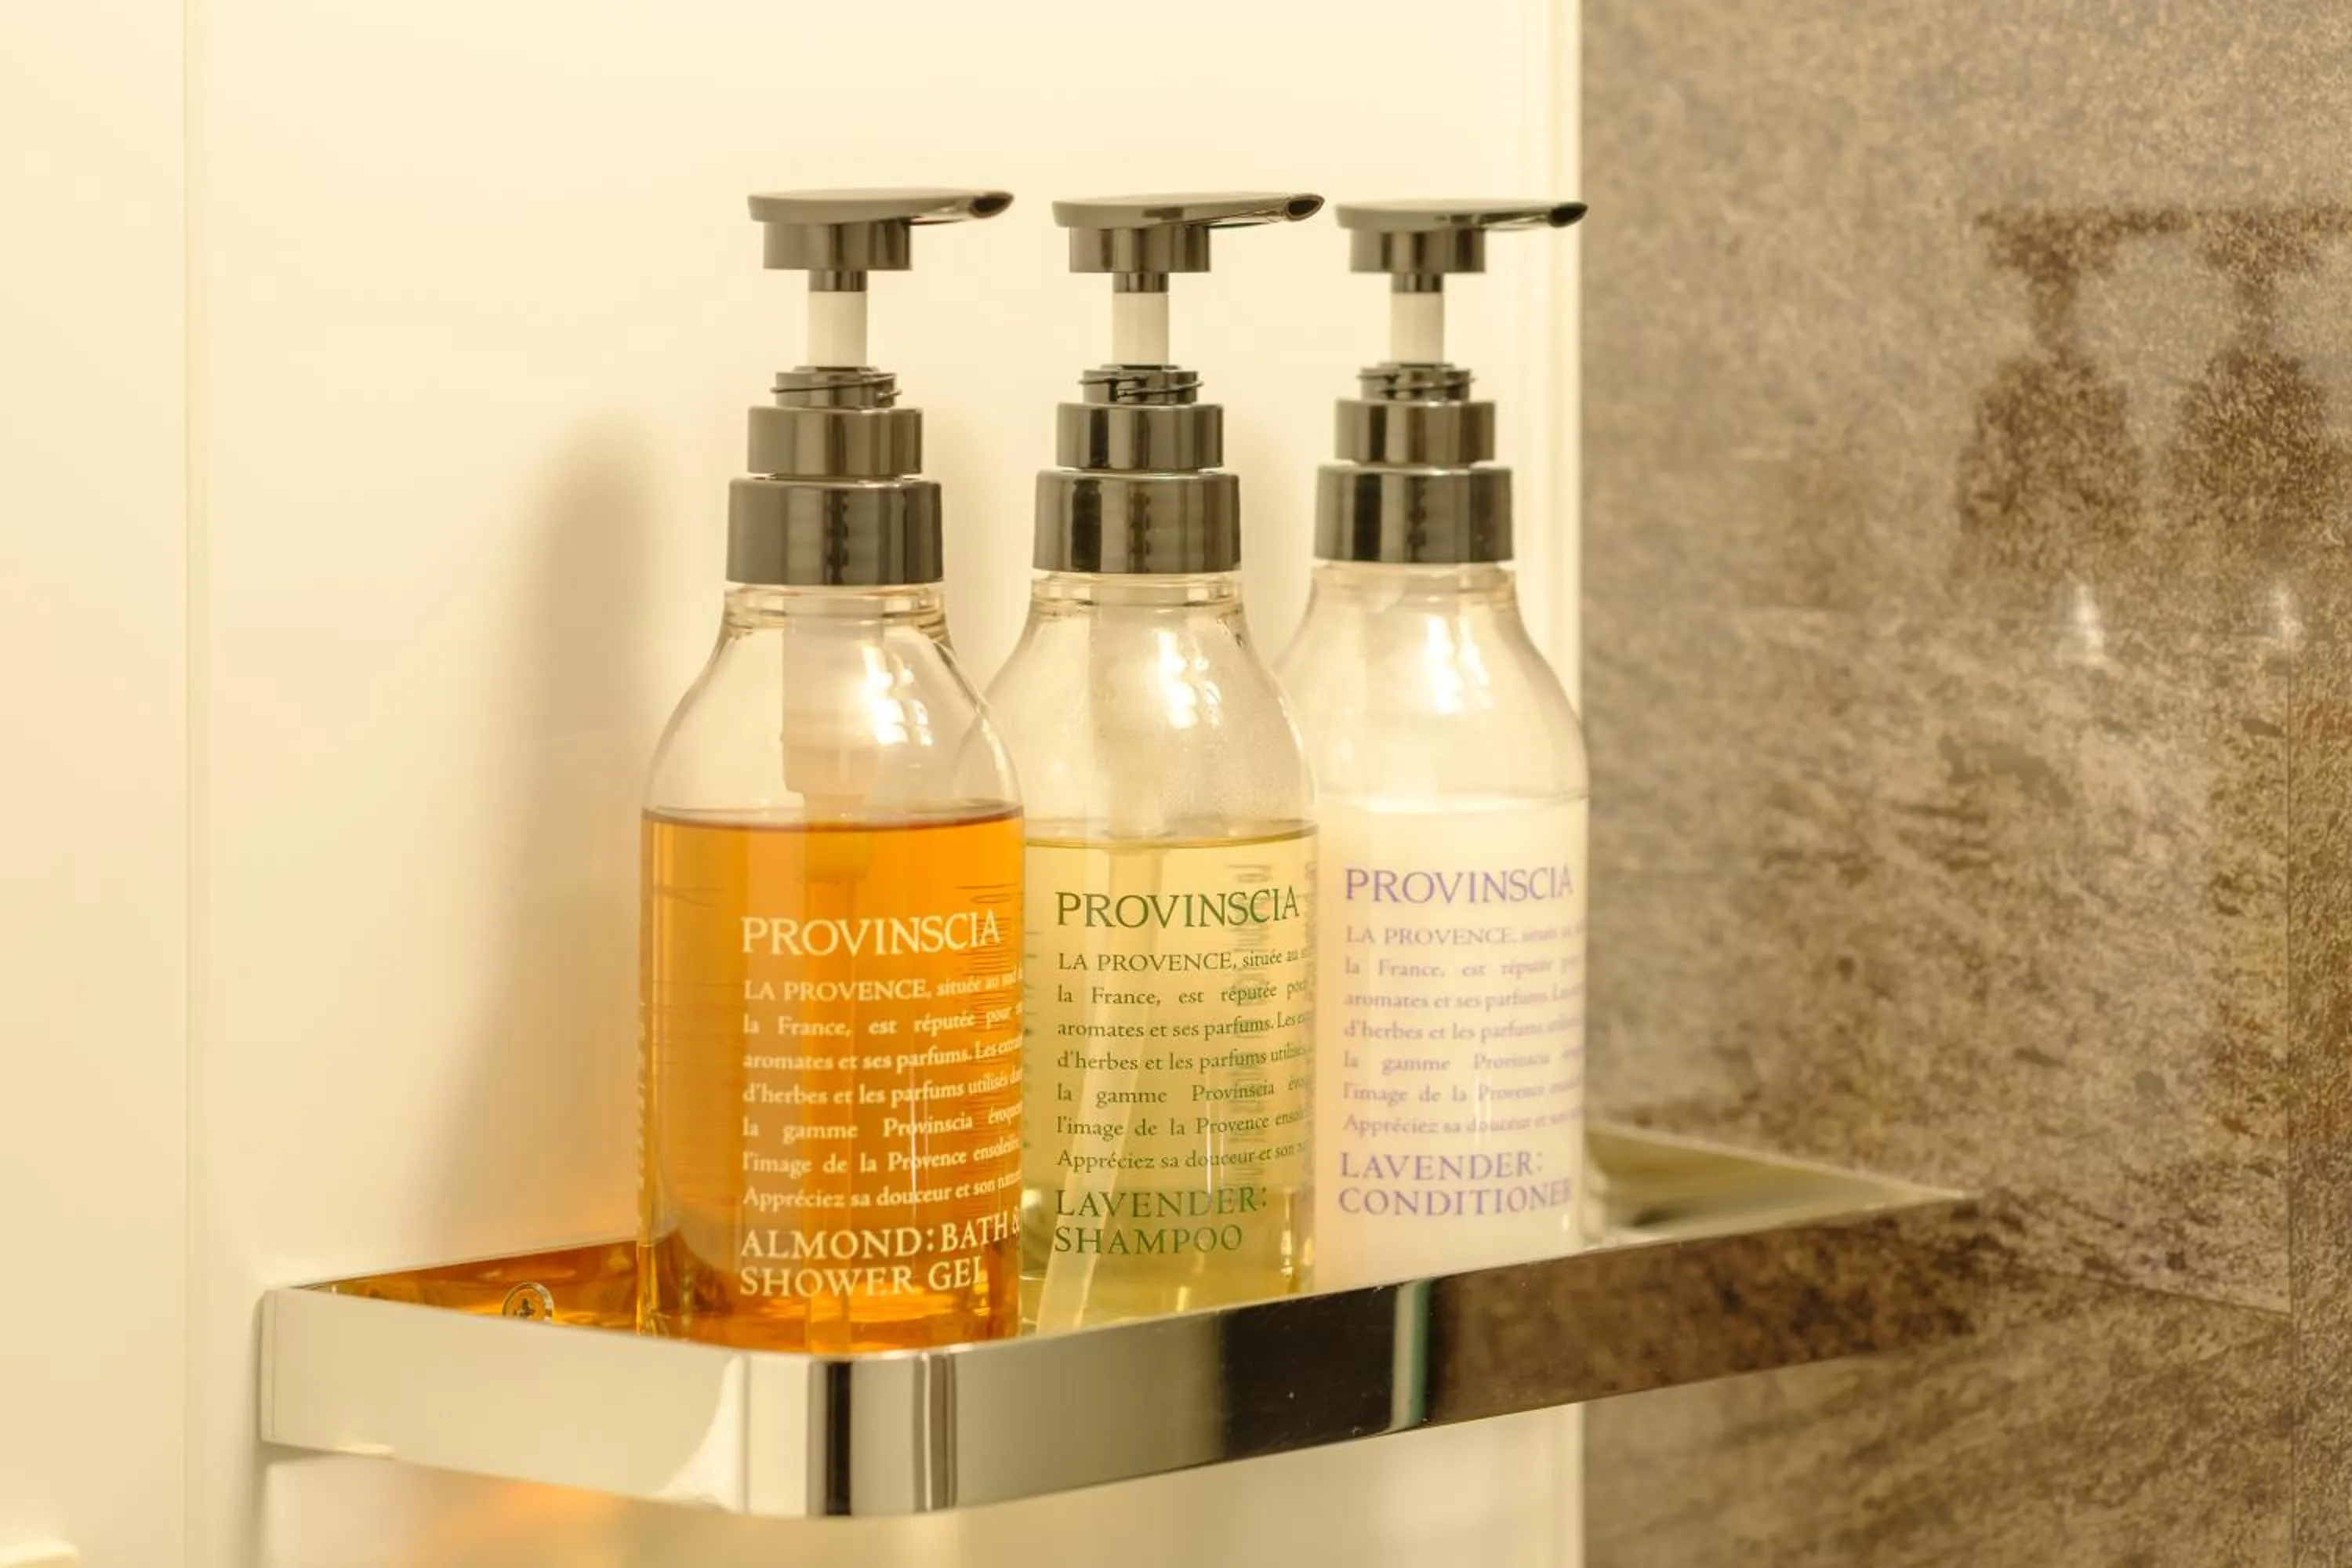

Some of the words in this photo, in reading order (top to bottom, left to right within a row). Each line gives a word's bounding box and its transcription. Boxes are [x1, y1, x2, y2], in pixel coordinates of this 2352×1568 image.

[1345, 865, 1574, 904] PROVINSCIA
[1055, 885, 1299, 929] PROVINSCIA
[741, 909, 1001, 957] PROVINSCIA
[1346, 926, 1375, 943] LA
[1384, 926, 1517, 946] PROVENCE,
[1058, 953, 1088, 971] LA
[1098, 952, 1236, 971] PROVENCE,
[1243, 949, 1282, 967] située
[1345, 956, 1360, 975] la
[1378, 958, 1445, 978] France,
[1461, 963, 1486, 977] est
[745, 979, 775, 1001] LA
[785, 978, 931, 1001] PROVENCE,
[1058, 985, 1073, 1004] la
[1092, 987, 1161, 1006] France,
[1179, 990, 1204, 1004] est
[1221, 981, 1277, 1007] réputée
[1344, 993, 1428, 1009] aromates
[1434, 995, 1450, 1009] et
[1456, 994, 1483, 1009] ses
[743, 1014, 760, 1034] la
[779, 1016, 852, 1038] France,
[869, 1018, 896, 1035] est
[914, 1009, 975, 1037] réputée
[1057, 1022, 1144, 1037] aromates
[1150, 1024, 1167, 1037] et
[1173, 1024, 1199, 1037] ses
[1205, 1014, 1274, 1041] parfums.
[1429, 1026, 1445, 1040] et
[1452, 1022, 1475, 1040] les
[743, 1051, 833, 1070] aromates
[839, 1053, 857, 1070] et
[863, 1053, 891, 1069] ses
[897, 1043, 972, 1074] parfums.
[1057, 1051, 1138, 1071] d'herbes
[1145, 1056, 1163, 1070] et
[1170, 1051, 1192, 1070] les
[1200, 1048, 1266, 1073] parfums
[1343, 1051, 1359, 1069] la
[1382, 1058, 1450, 1075] gamme
[743, 1081, 827, 1104] d'herbes
[834, 1088, 852, 1104] et
[859, 1083, 885, 1104] les
[891, 1079, 964, 1108] parfums
[1057, 1083, 1073, 1102] la
[1097, 1091, 1168, 1109] gamme
[1192, 1079, 1275, 1102] Provinscia
[1419, 1085, 1441, 1102] de
[1452, 1085, 1468, 1102] la
[743, 1118, 760, 1137] la
[784, 1124, 858, 1144] gamme
[884, 1111, 973, 1138] Provinscia
[1134, 1119, 1158, 1136] de
[1170, 1118, 1185, 1136] la
[1196, 1116, 1269, 1134] Provence
[1343, 1114, 1439, 1137] Appréciez
[1444, 1120, 1461, 1134] sa
[823, 1153, 848, 1172] de
[861, 1153, 877, 1172] la
[888, 1150, 967, 1172] Provence
[1057, 1149, 1155, 1173] Appréciez
[1161, 1155, 1178, 1168] sa
[1185, 1149, 1254, 1167] douceur
[1258, 1148, 1272, 1161] et
[1340, 1151, 1543, 1181] LAVENDER:
[743, 1189, 844, 1211] Appréciez
[851, 1193, 870, 1207] sa
[877, 1186, 952, 1207] douceur
[955, 1183, 971, 1199] et
[973, 1180, 995, 1196] son
[1055, 1186, 1267, 1218] LAVENDER:
[1054, 1224, 1243, 1255] SHAMPOO
[741, 1265, 915, 1298] SHOWER
[928, 1255, 986, 1291] GEL
